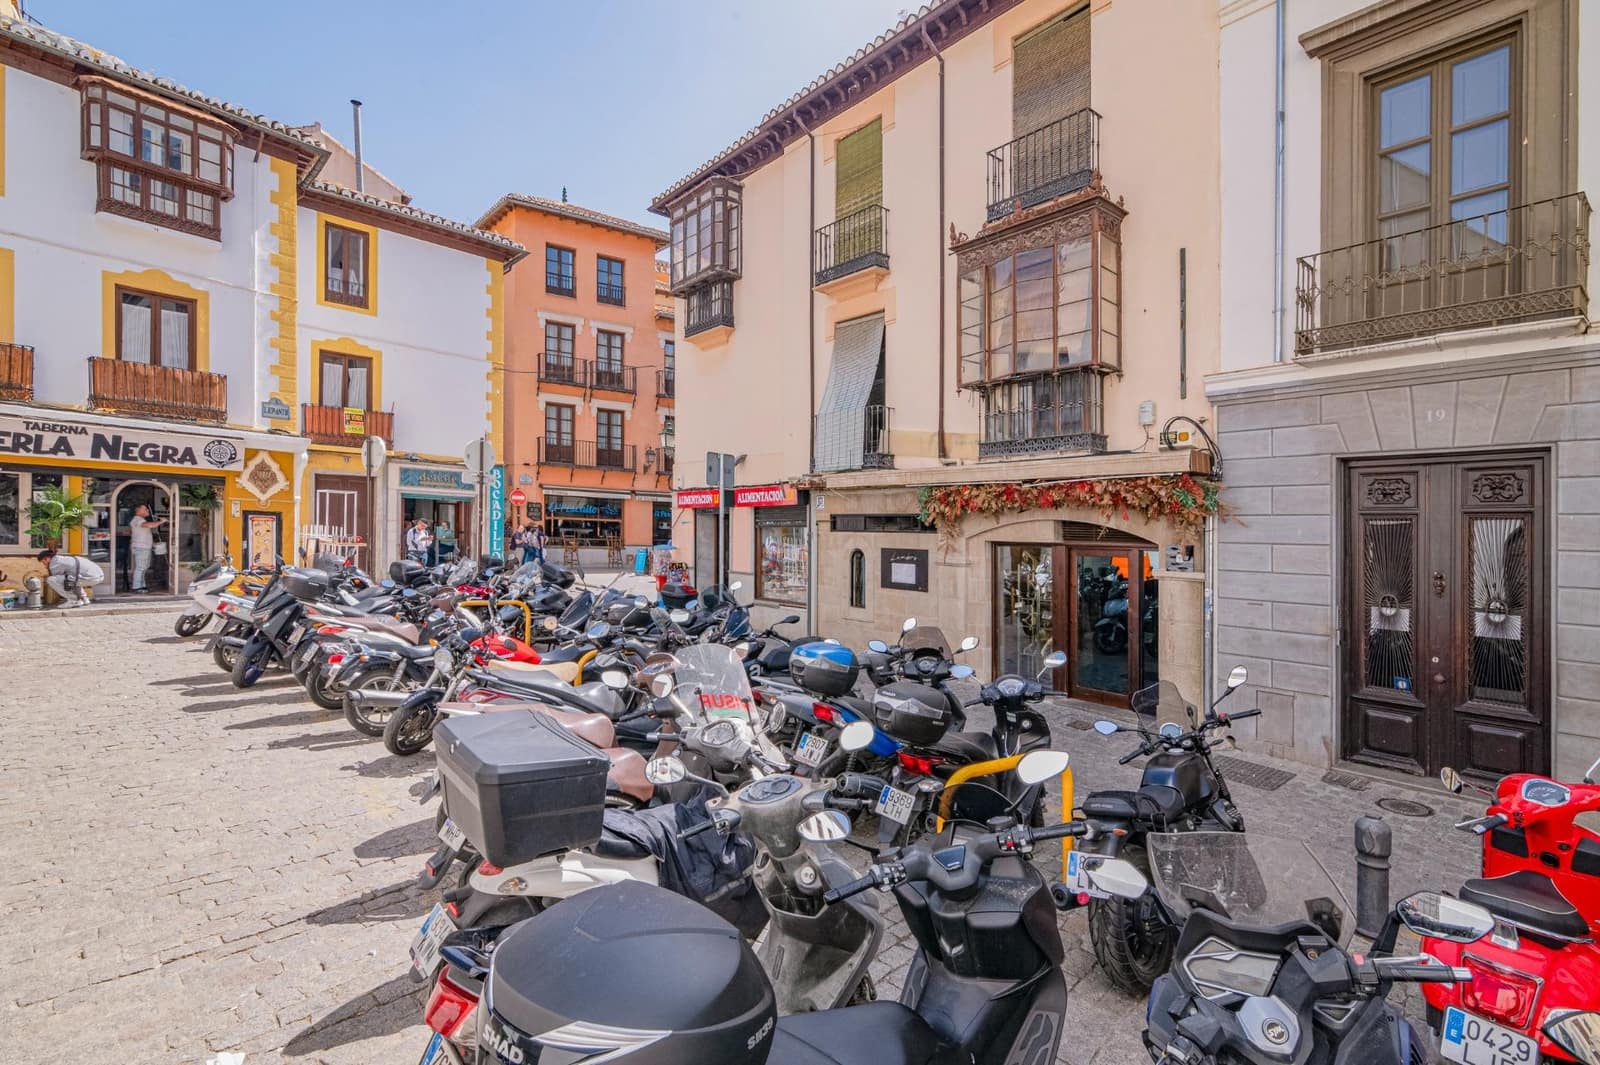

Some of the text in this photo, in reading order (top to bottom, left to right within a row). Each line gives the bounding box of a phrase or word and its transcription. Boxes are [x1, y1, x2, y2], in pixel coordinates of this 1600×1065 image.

[23, 421, 88, 435] TABERNA
[1427, 409, 1446, 422] 19
[91, 433, 198, 465] NEGRA
[889, 787, 913, 809] 9369
[483, 1024, 524, 1065] SHAD
[1466, 1020, 1531, 1062] 0429
